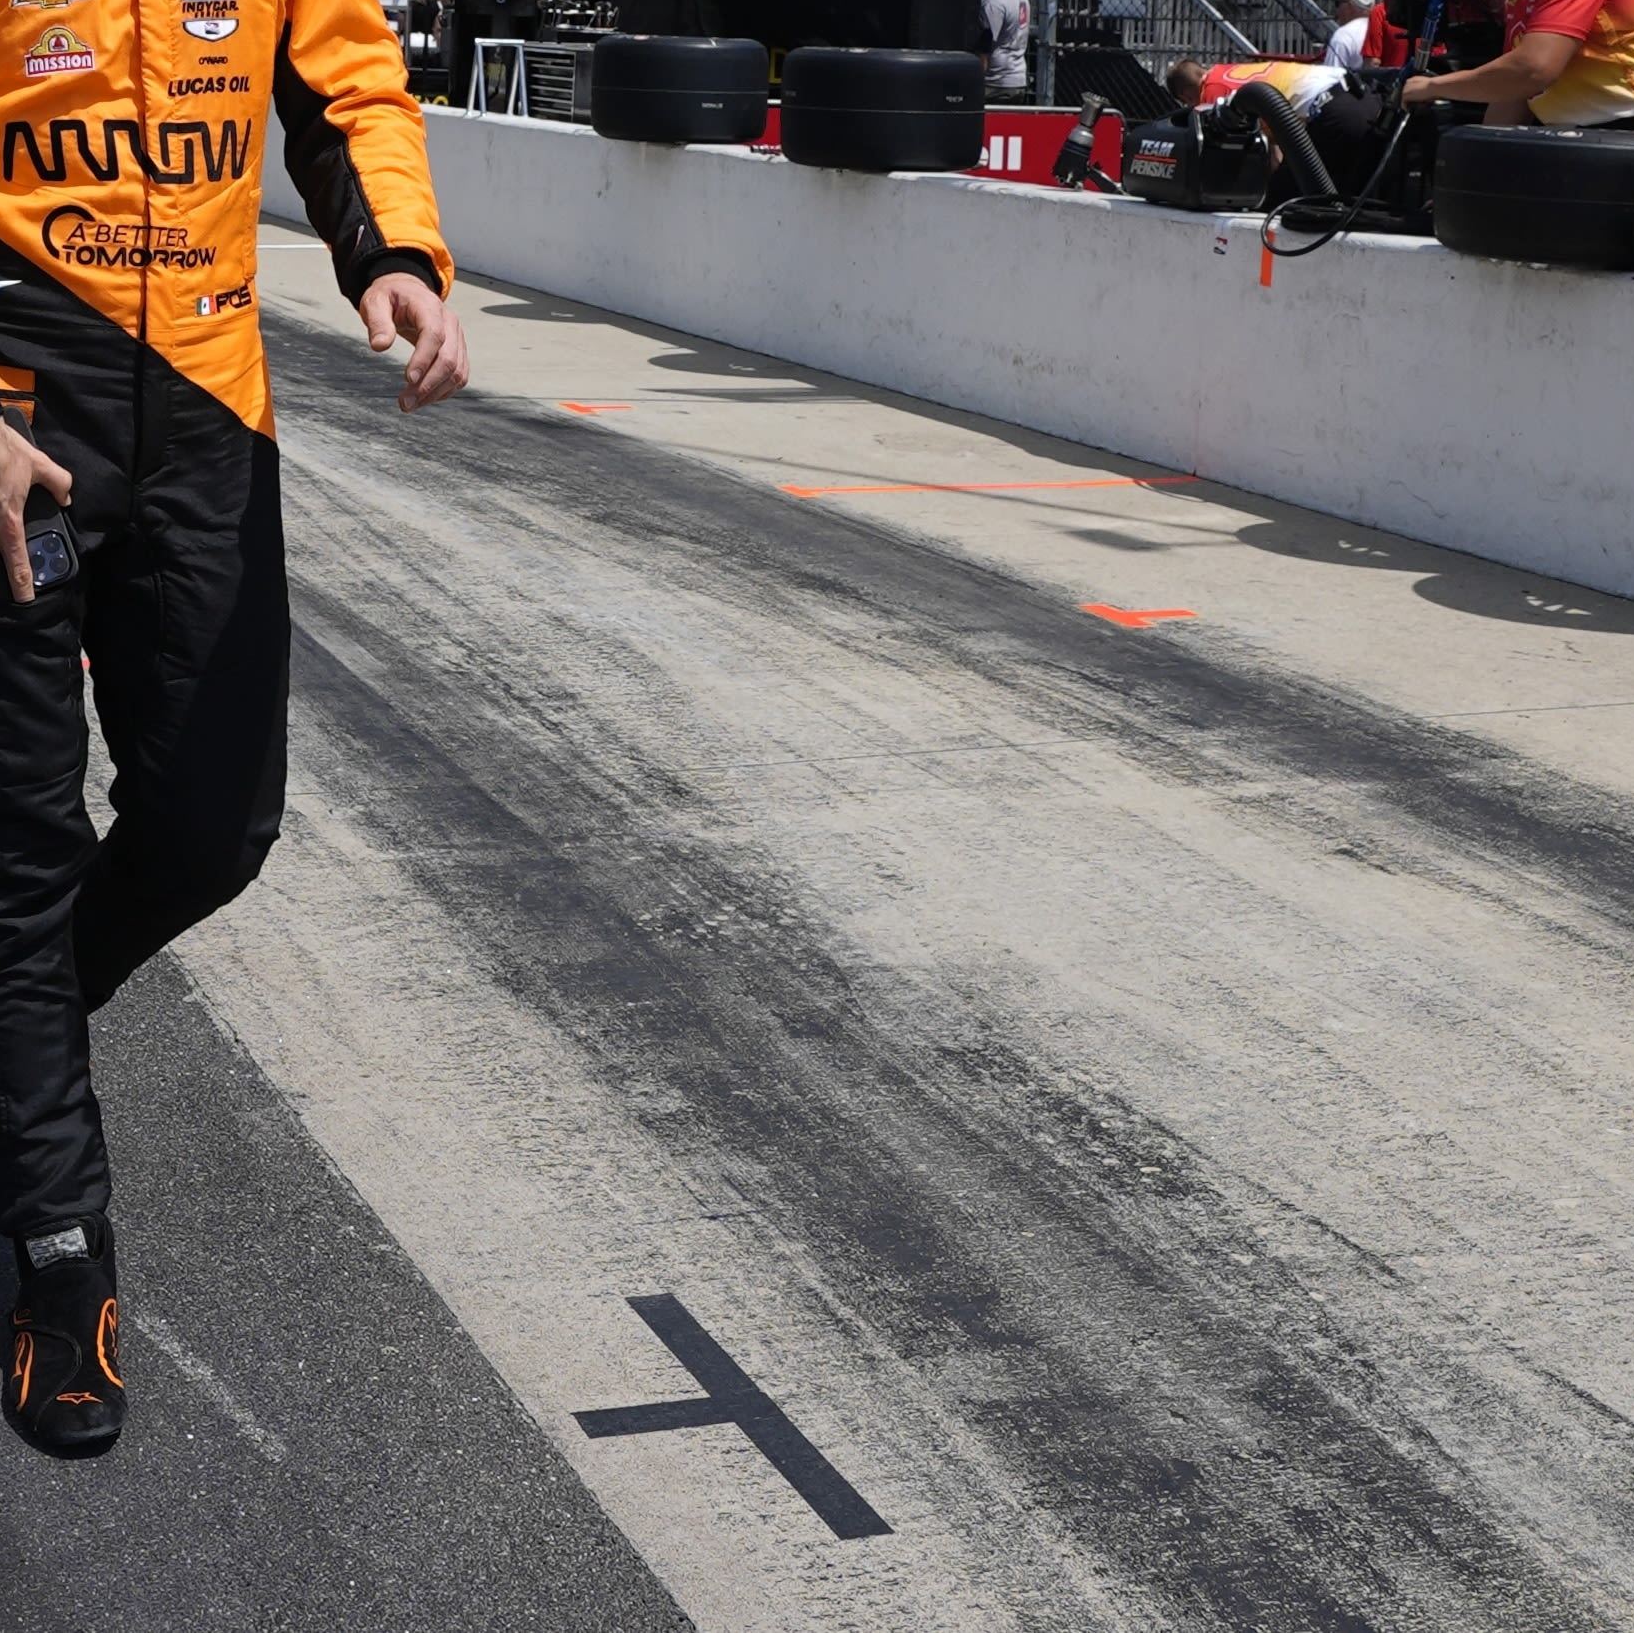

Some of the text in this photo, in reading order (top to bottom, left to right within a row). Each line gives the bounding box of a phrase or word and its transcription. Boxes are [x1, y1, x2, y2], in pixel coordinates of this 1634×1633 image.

[182, 0, 239, 14] INDYCAR
[167, 75, 250, 97] LUCAS OIL
[3, 118, 252, 185] ARROW
[1138, 139, 1175, 157] TEAM
[1129, 158, 1177, 179] PENSKE
[67, 223, 188, 247] A BETTER
[63, 244, 217, 269] TOMORROW
